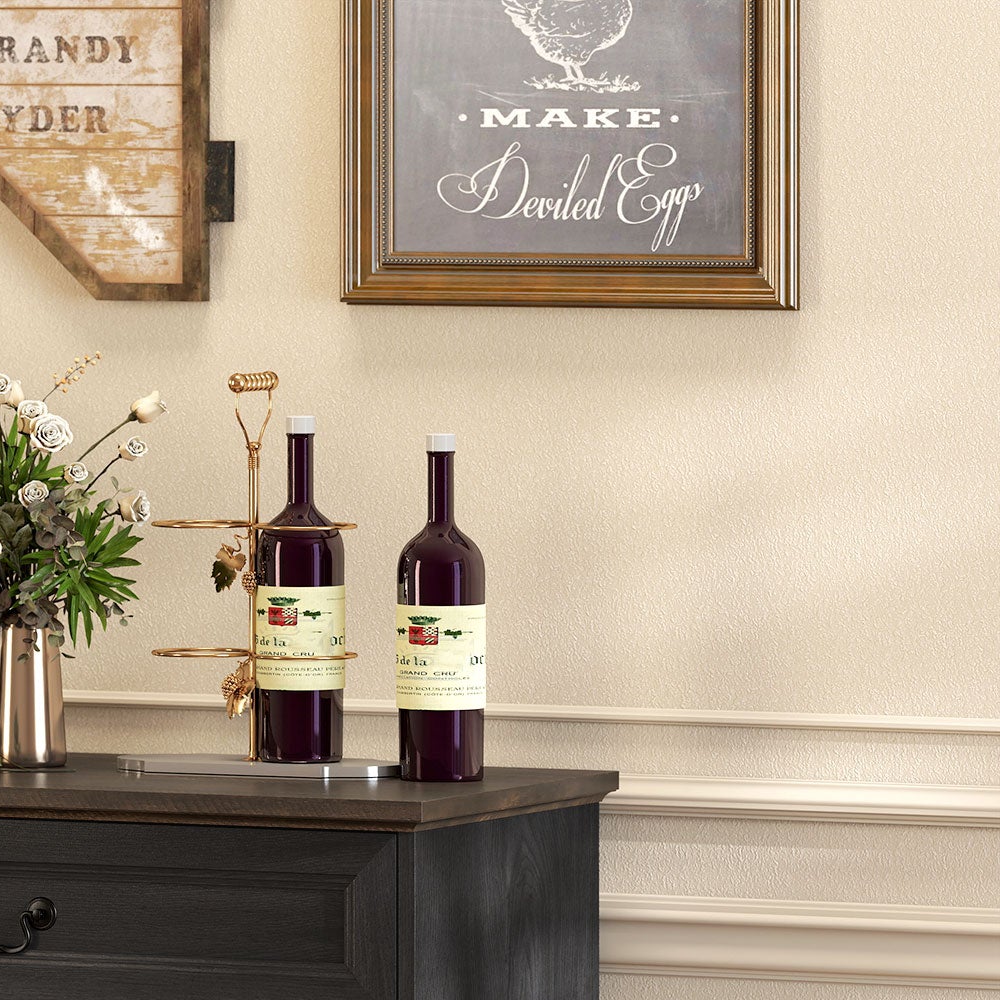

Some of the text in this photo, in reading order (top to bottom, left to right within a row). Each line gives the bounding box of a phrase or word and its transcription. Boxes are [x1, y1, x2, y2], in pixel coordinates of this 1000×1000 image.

[480, 108, 661, 128] MAKE
[437, 141, 704, 251] Deviled Eggs
